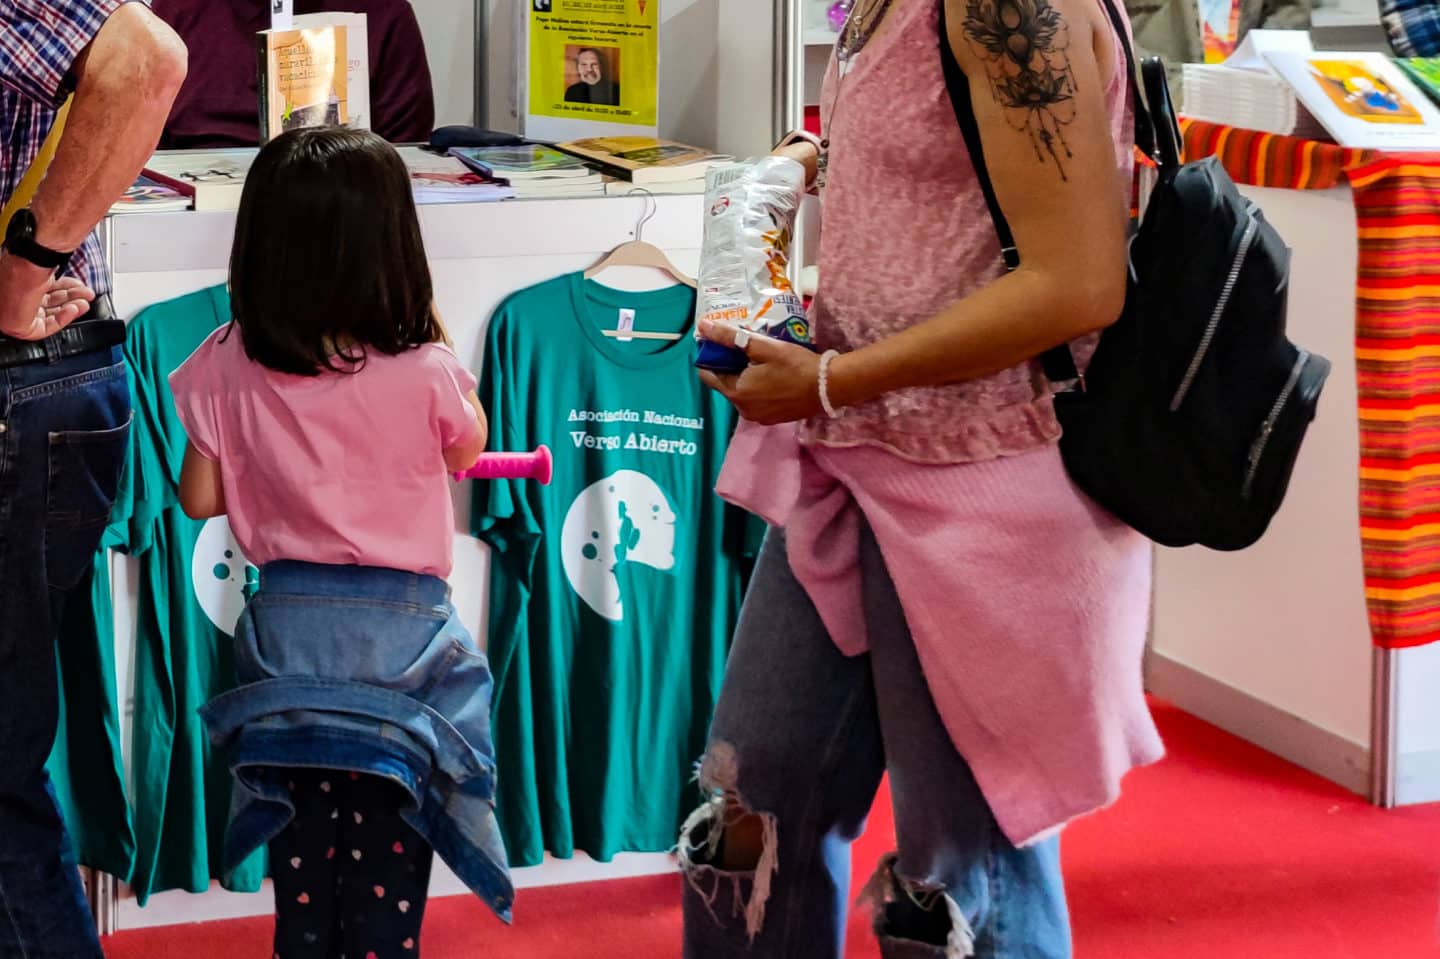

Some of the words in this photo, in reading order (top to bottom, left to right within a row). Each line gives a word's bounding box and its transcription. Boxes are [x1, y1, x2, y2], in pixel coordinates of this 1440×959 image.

[568, 408, 639, 423] Asociación
[643, 410, 704, 429] Nacional
[570, 431, 620, 450] Verso
[624, 432, 697, 456] Abierto
